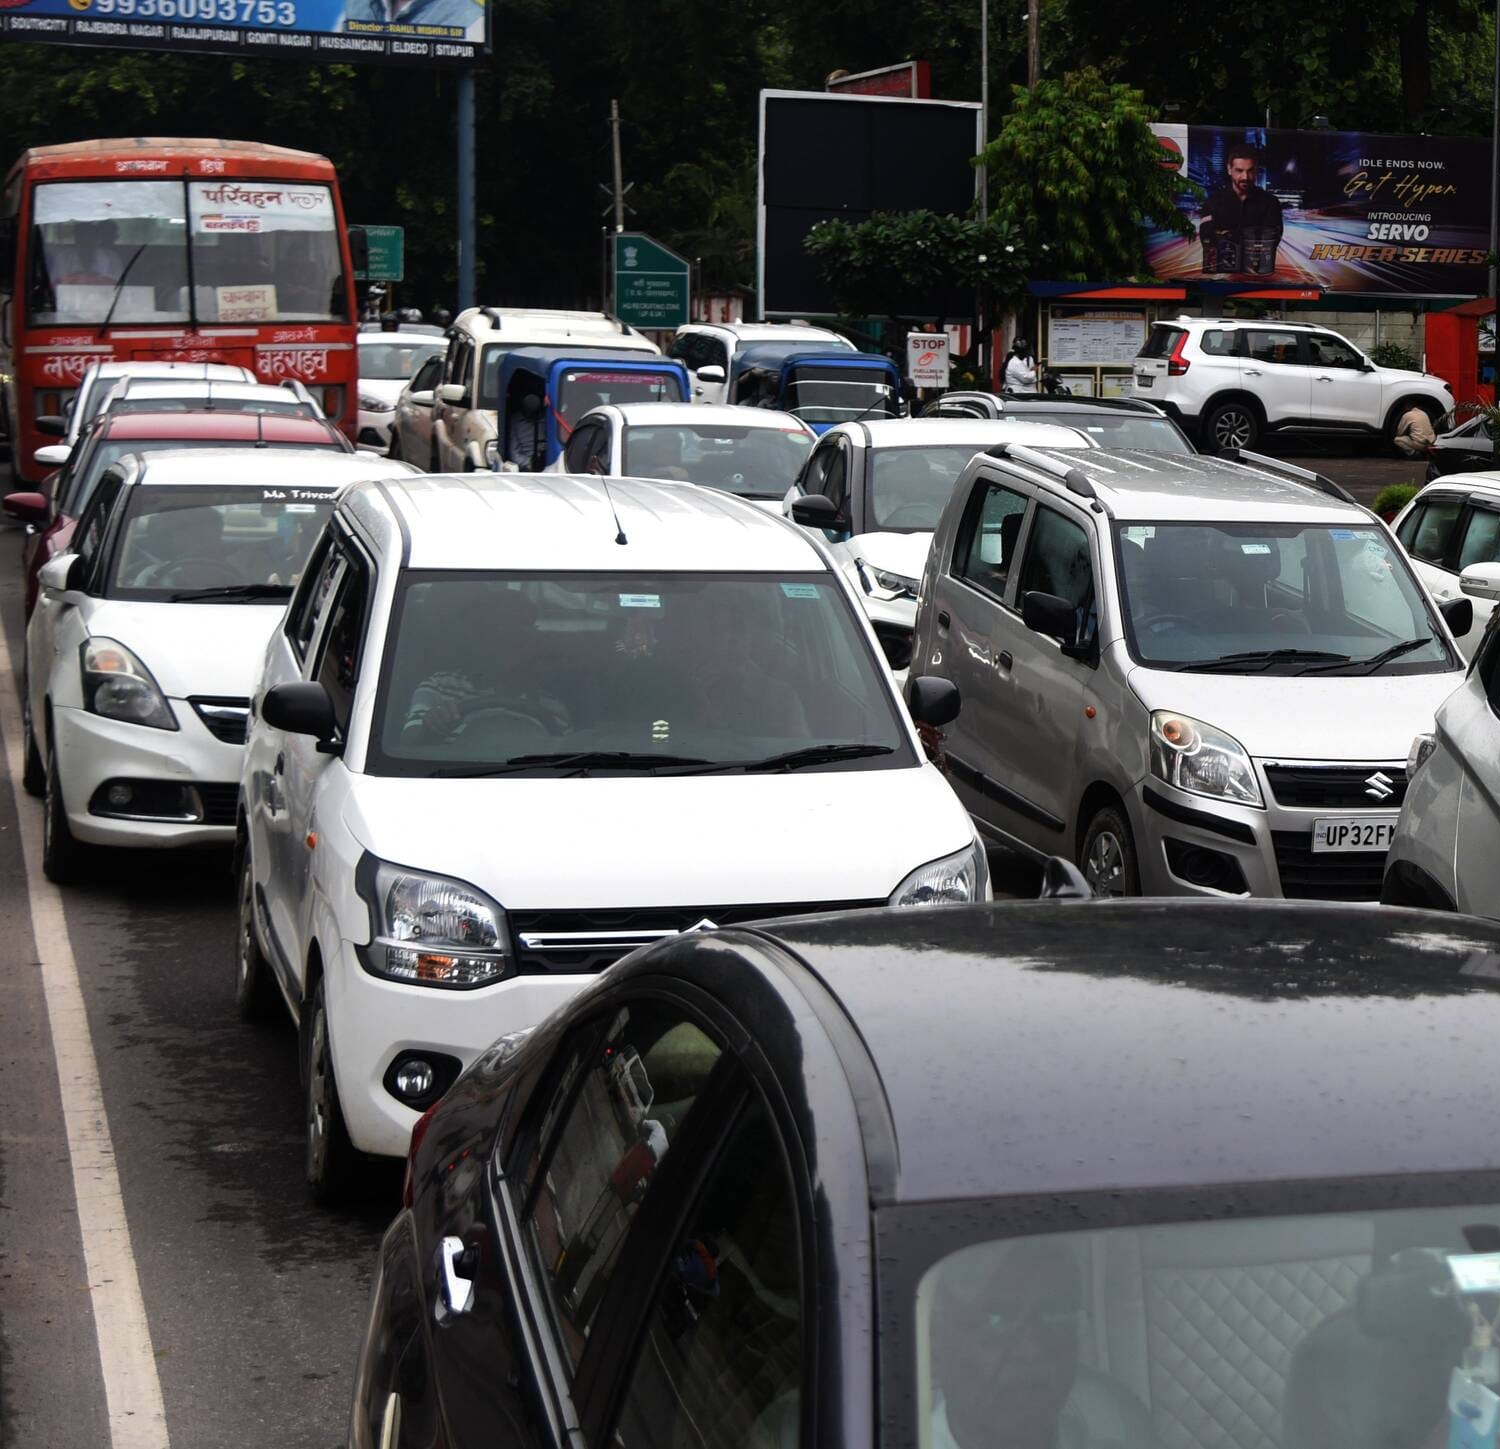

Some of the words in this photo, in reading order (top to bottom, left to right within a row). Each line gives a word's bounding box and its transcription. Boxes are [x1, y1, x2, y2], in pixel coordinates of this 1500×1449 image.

[348, 20, 384, 32] Director
[10, 17, 68, 31] SOUTHCITY
[76, 20, 128, 35] RAJENDRA
[130, 24, 164, 38] NAGAR
[171, 27, 239, 42] RAJAJIPURAM
[247, 32, 278, 45] GOMTI
[280, 35, 312, 47] NAGAR
[320, 38, 385, 51] HUSSAINGANJ
[393, 41, 428, 55] ELDECO
[436, 44, 474, 57] SITAPUR
[1359, 158, 1382, 168] IDLE
[1386, 160, 1414, 169] ENDS
[1418, 161, 1446, 170] NOW.
[1343, 171, 1397, 200] Get
[1393, 174, 1457, 208] Hyper.
[1368, 212, 1431, 222] INTRODUCING
[1367, 223, 1430, 241] SERVO
[1310, 244, 1398, 263] HYPER
[1398, 246, 1489, 264] SERIES
[912, 339, 945, 349] STOP
